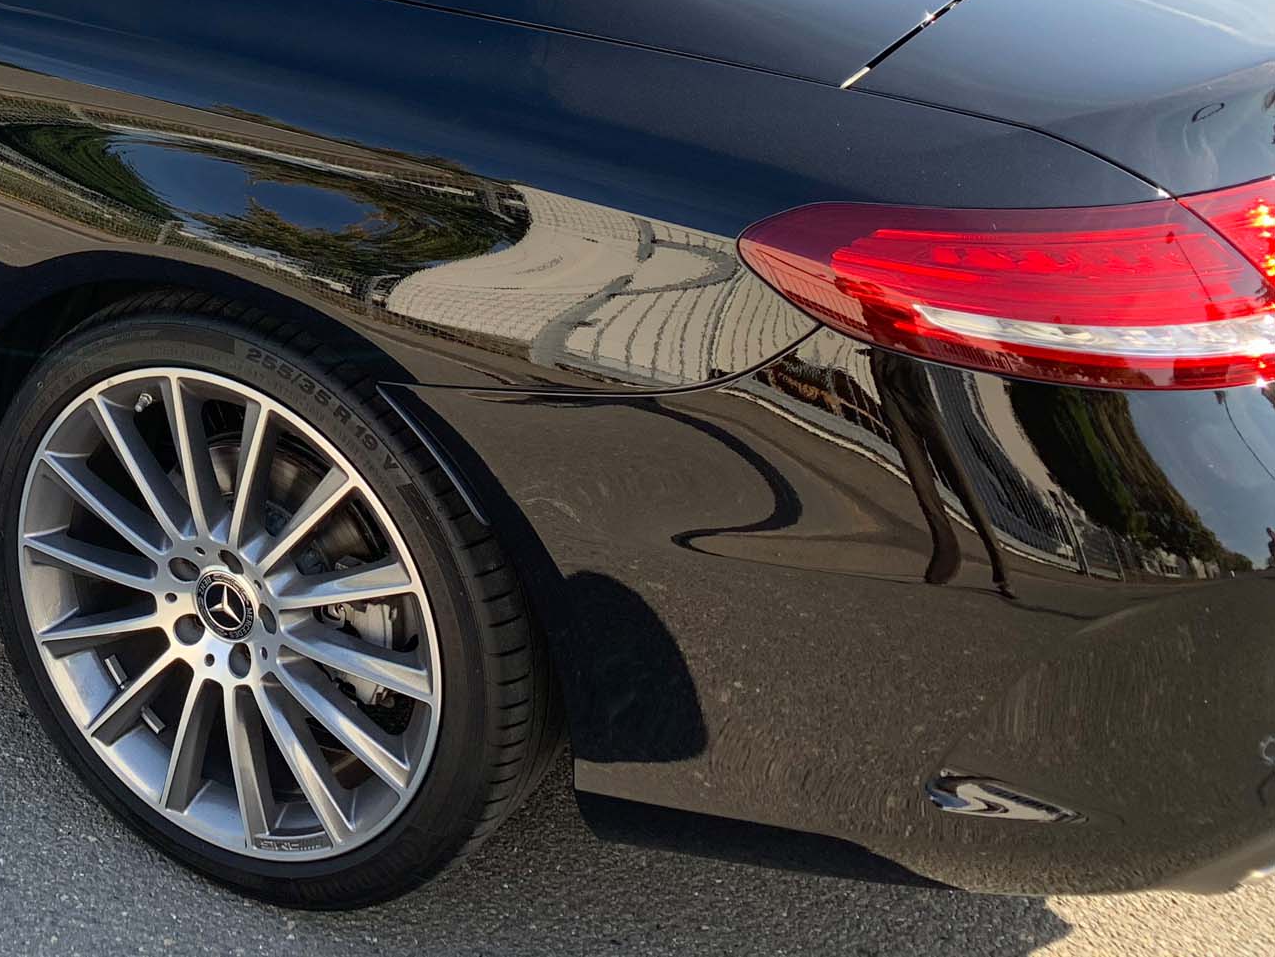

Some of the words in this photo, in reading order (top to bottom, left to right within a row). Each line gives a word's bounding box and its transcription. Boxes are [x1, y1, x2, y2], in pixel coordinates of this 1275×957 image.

[246, 347, 332, 407] 255/35
[333, 405, 352, 426] R
[355, 424, 378, 451] 19
